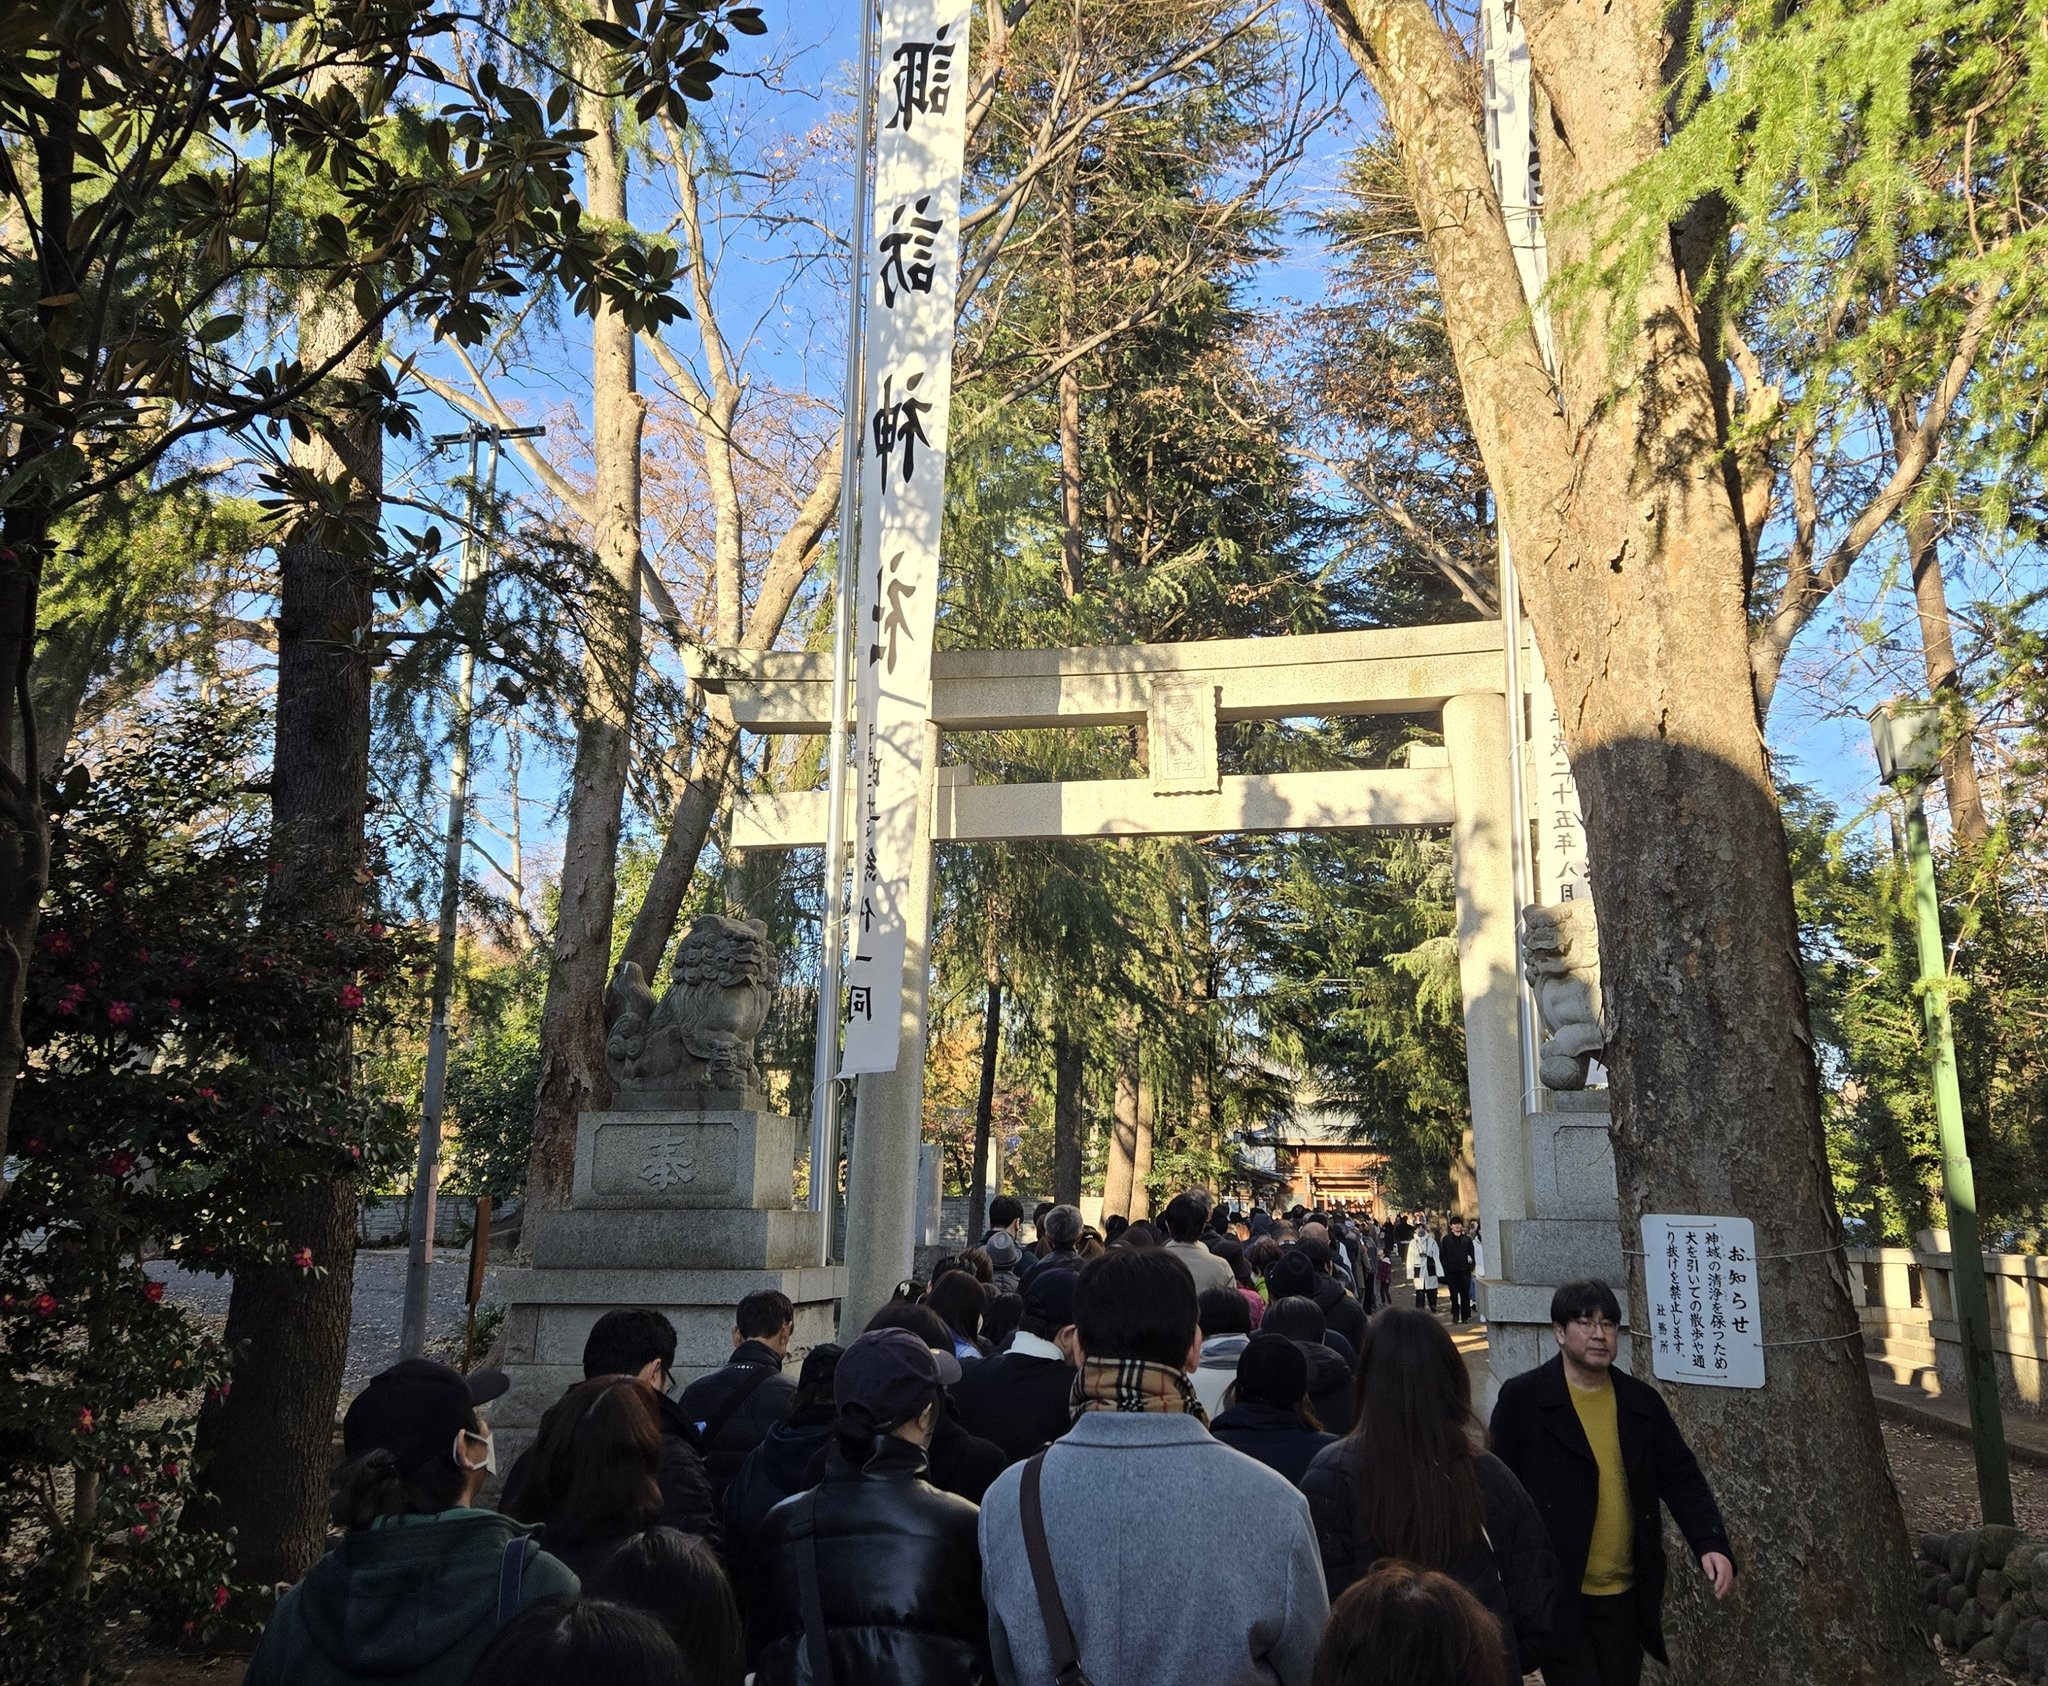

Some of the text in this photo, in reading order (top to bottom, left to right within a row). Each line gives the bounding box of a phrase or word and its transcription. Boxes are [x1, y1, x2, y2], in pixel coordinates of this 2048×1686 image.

[1656, 1303, 1669, 1355] 社務所
[1685, 1231, 1706, 1369] 犬を引いての散歩や通
[1704, 1231, 1728, 1370] 神域の清浄を保つため
[1727, 1246, 1750, 1334] お知らせ
